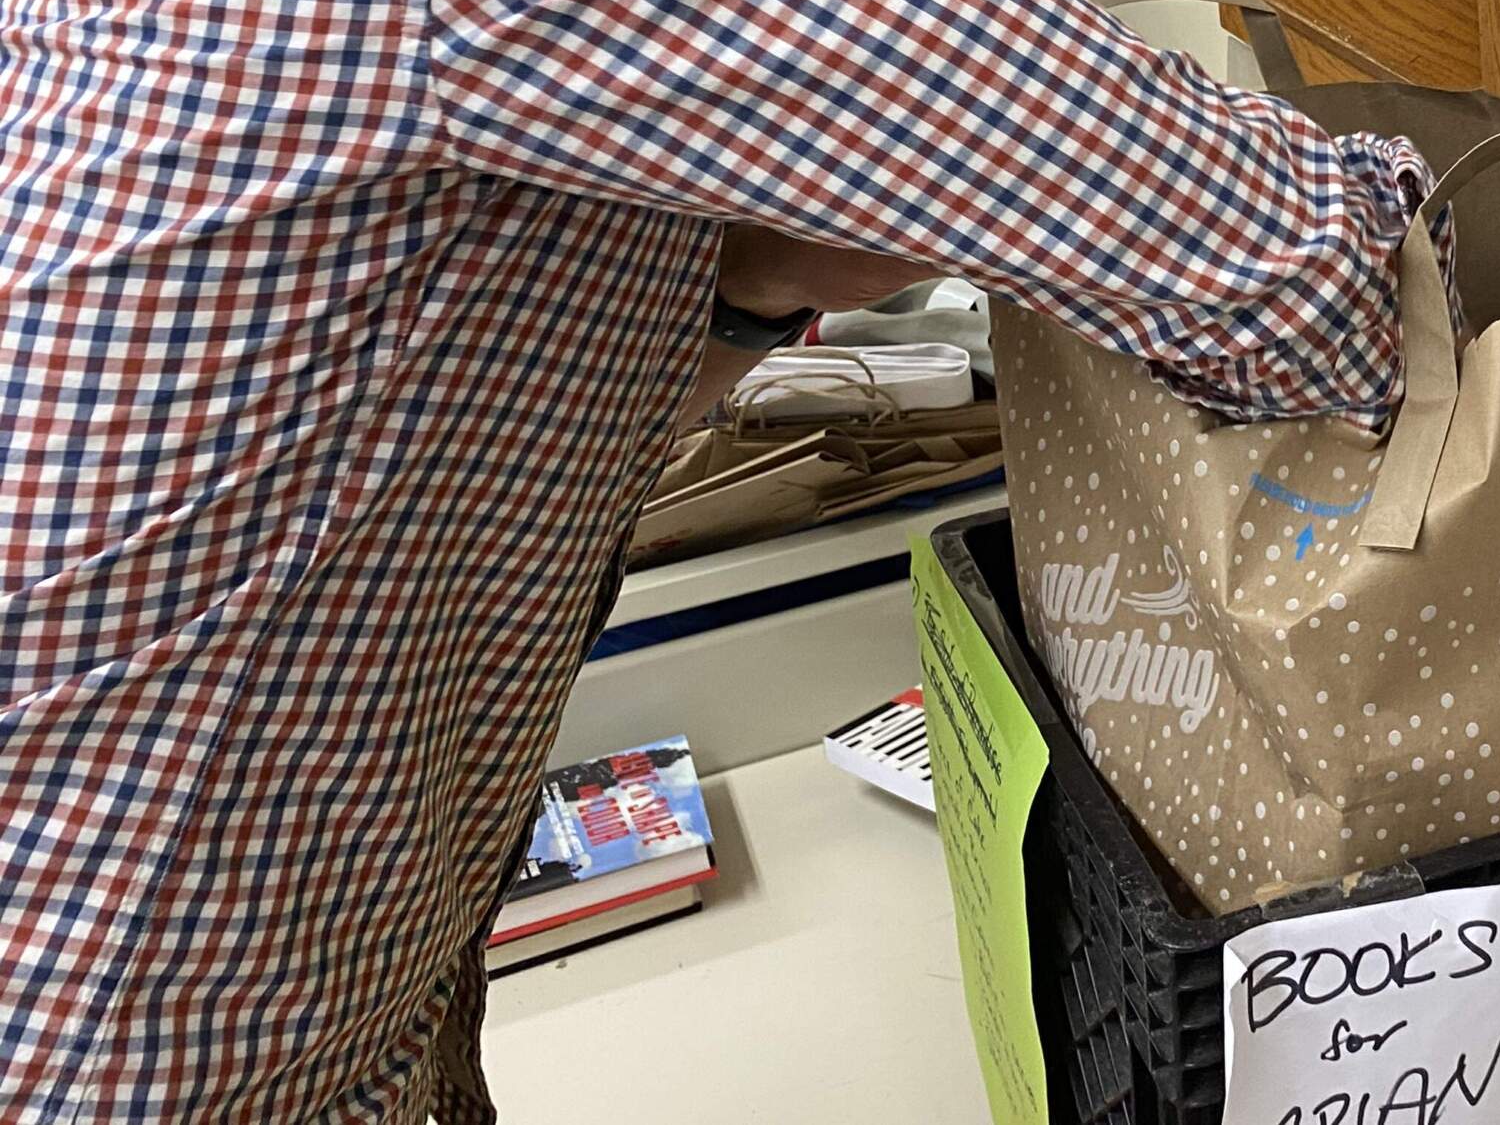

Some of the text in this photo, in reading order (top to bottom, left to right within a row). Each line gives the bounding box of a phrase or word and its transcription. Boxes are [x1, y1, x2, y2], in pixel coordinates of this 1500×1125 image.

[627, 796, 683, 848] SHAPE
[1241, 919, 1498, 1033] BOOKS
[1321, 1017, 1408, 1062] for
